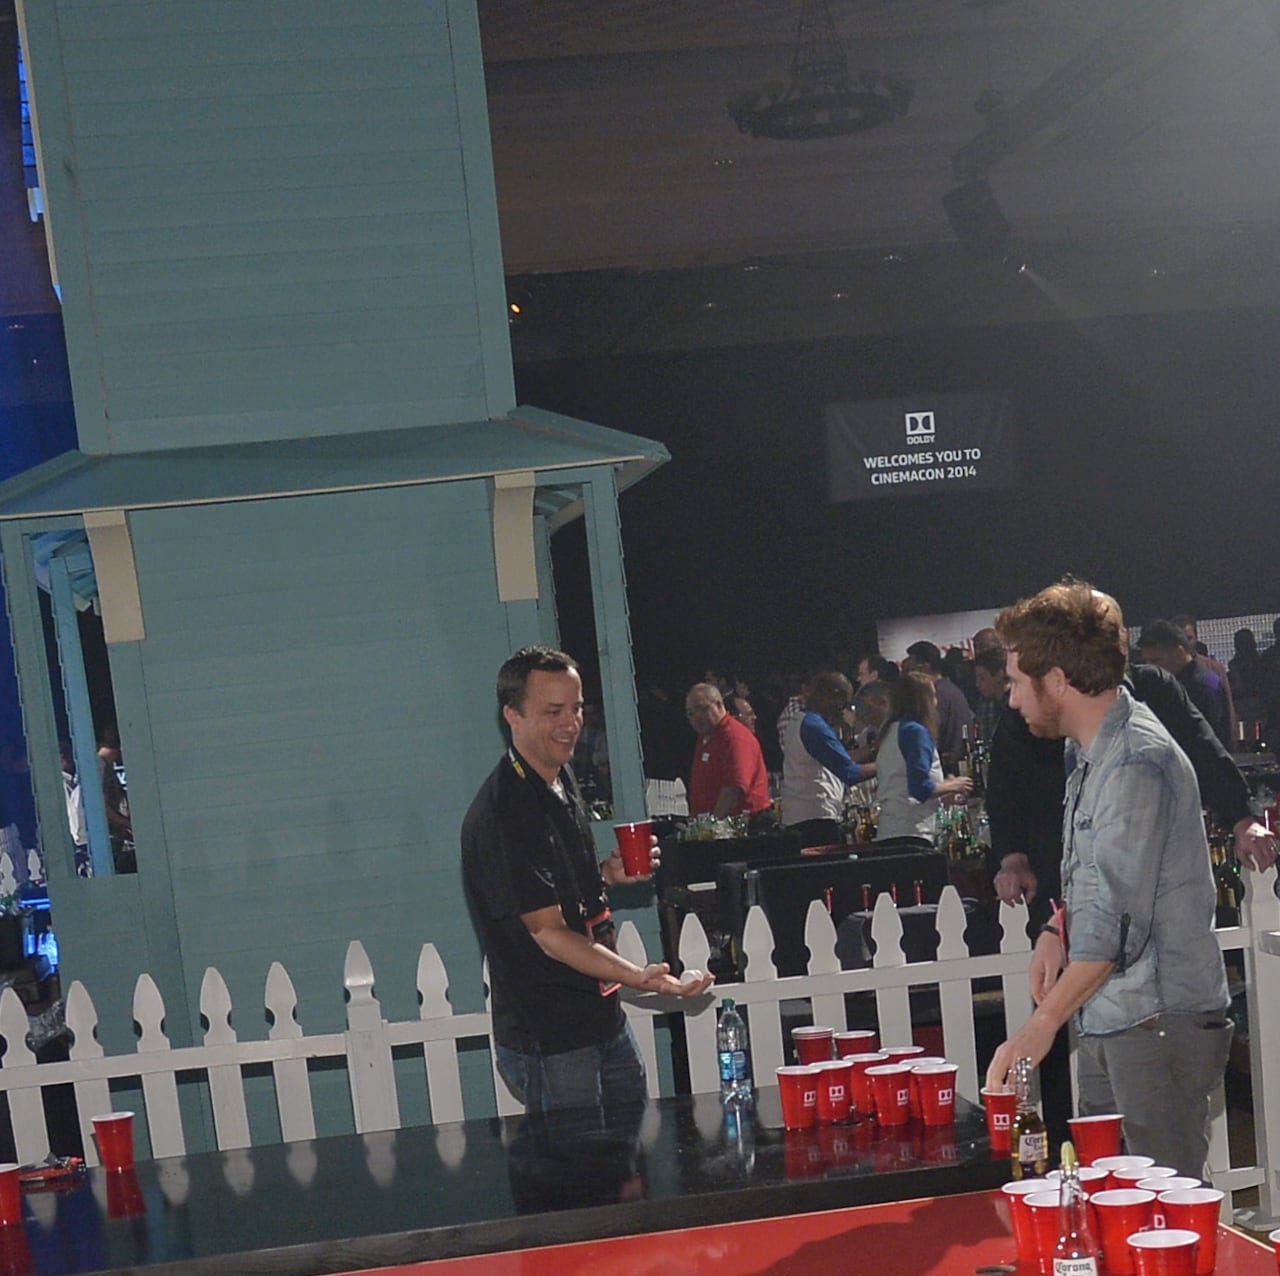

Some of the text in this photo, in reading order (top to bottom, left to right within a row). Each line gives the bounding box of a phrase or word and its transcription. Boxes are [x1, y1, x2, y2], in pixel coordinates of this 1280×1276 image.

[906, 434, 936, 445] DOLBY
[863, 448, 982, 469] WELCOMES YOU TO
[870, 465, 977, 485] CINEMACON 2014
[1055, 1261, 1093, 1274] Corona
